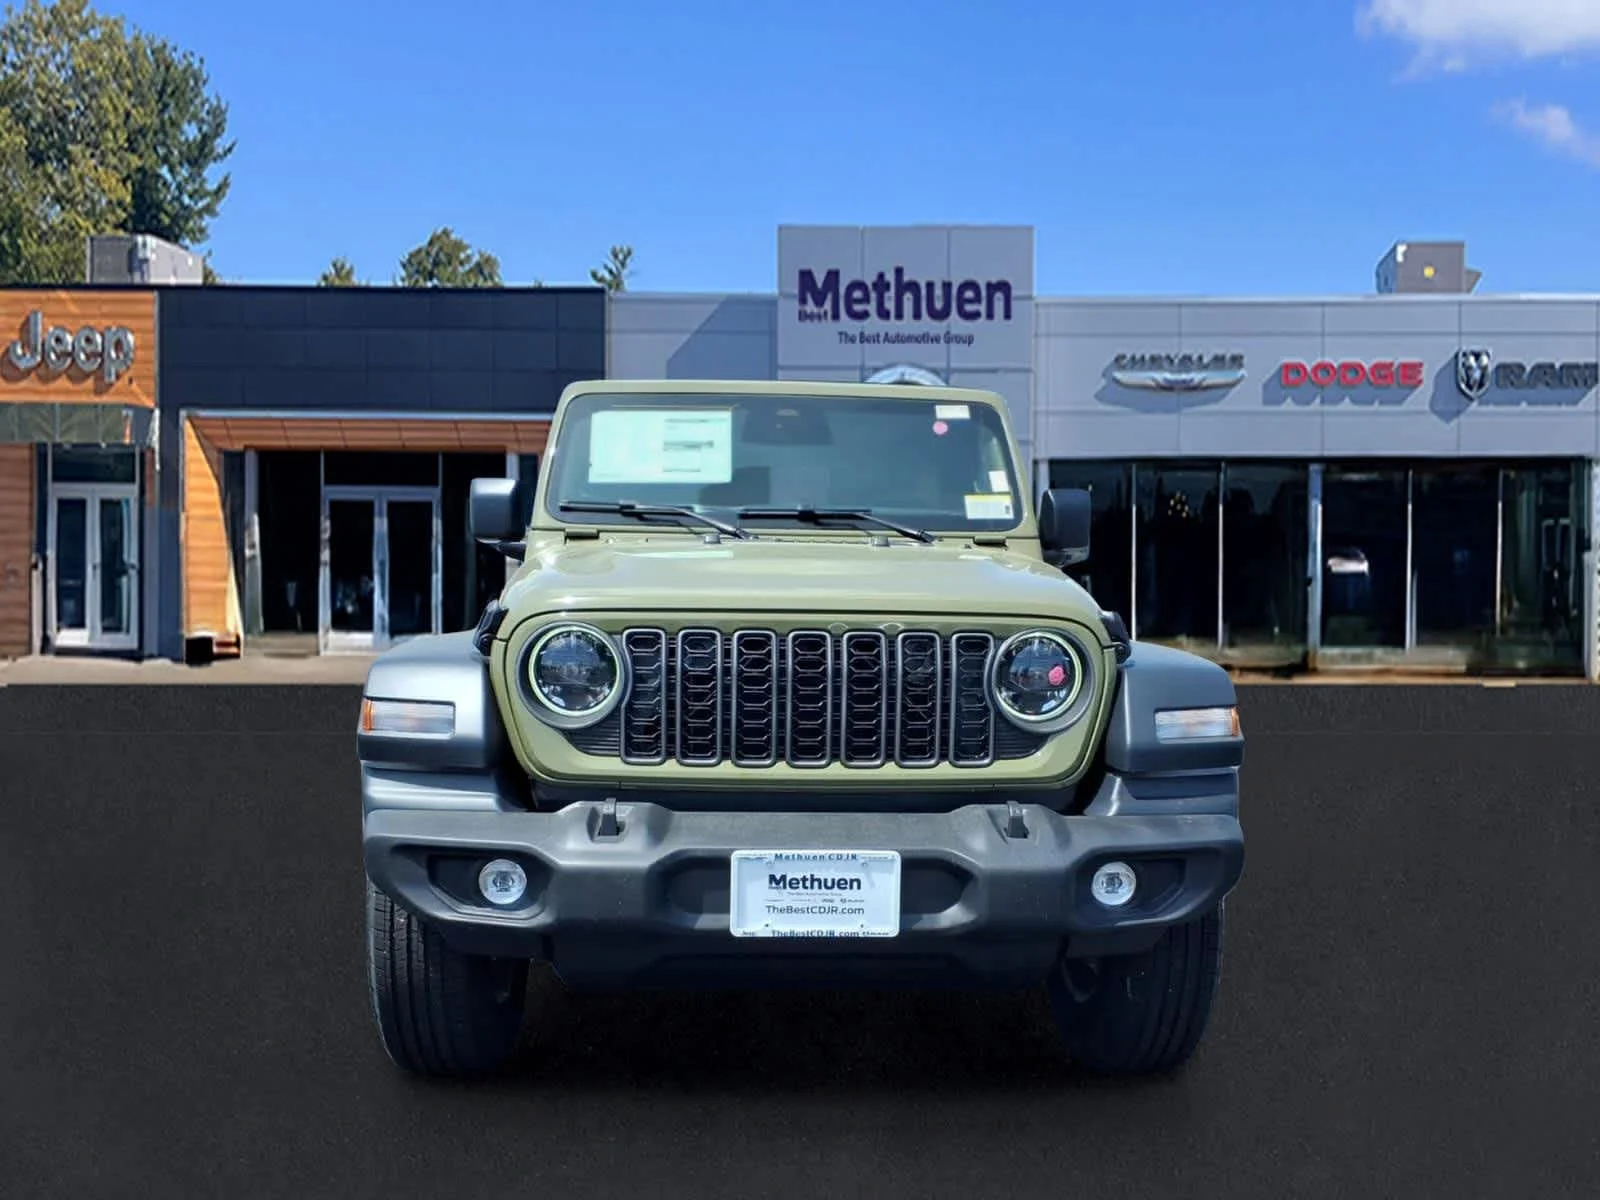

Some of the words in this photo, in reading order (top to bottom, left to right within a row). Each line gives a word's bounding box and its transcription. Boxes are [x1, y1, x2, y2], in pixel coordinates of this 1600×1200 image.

[798, 266, 1012, 322] Methuen
[10, 310, 135, 384] Jeep
[838, 331, 857, 344] The
[859, 331, 880, 344] Best
[883, 331, 941, 344] Automotive
[943, 331, 974, 347] Group
[1281, 361, 1424, 386] DODGE
[1494, 361, 1598, 389] RAM
[774, 853, 825, 862] Methuen
[768, 873, 862, 891] Methuen
[765, 904, 865, 915] TheBestCDJR.com
